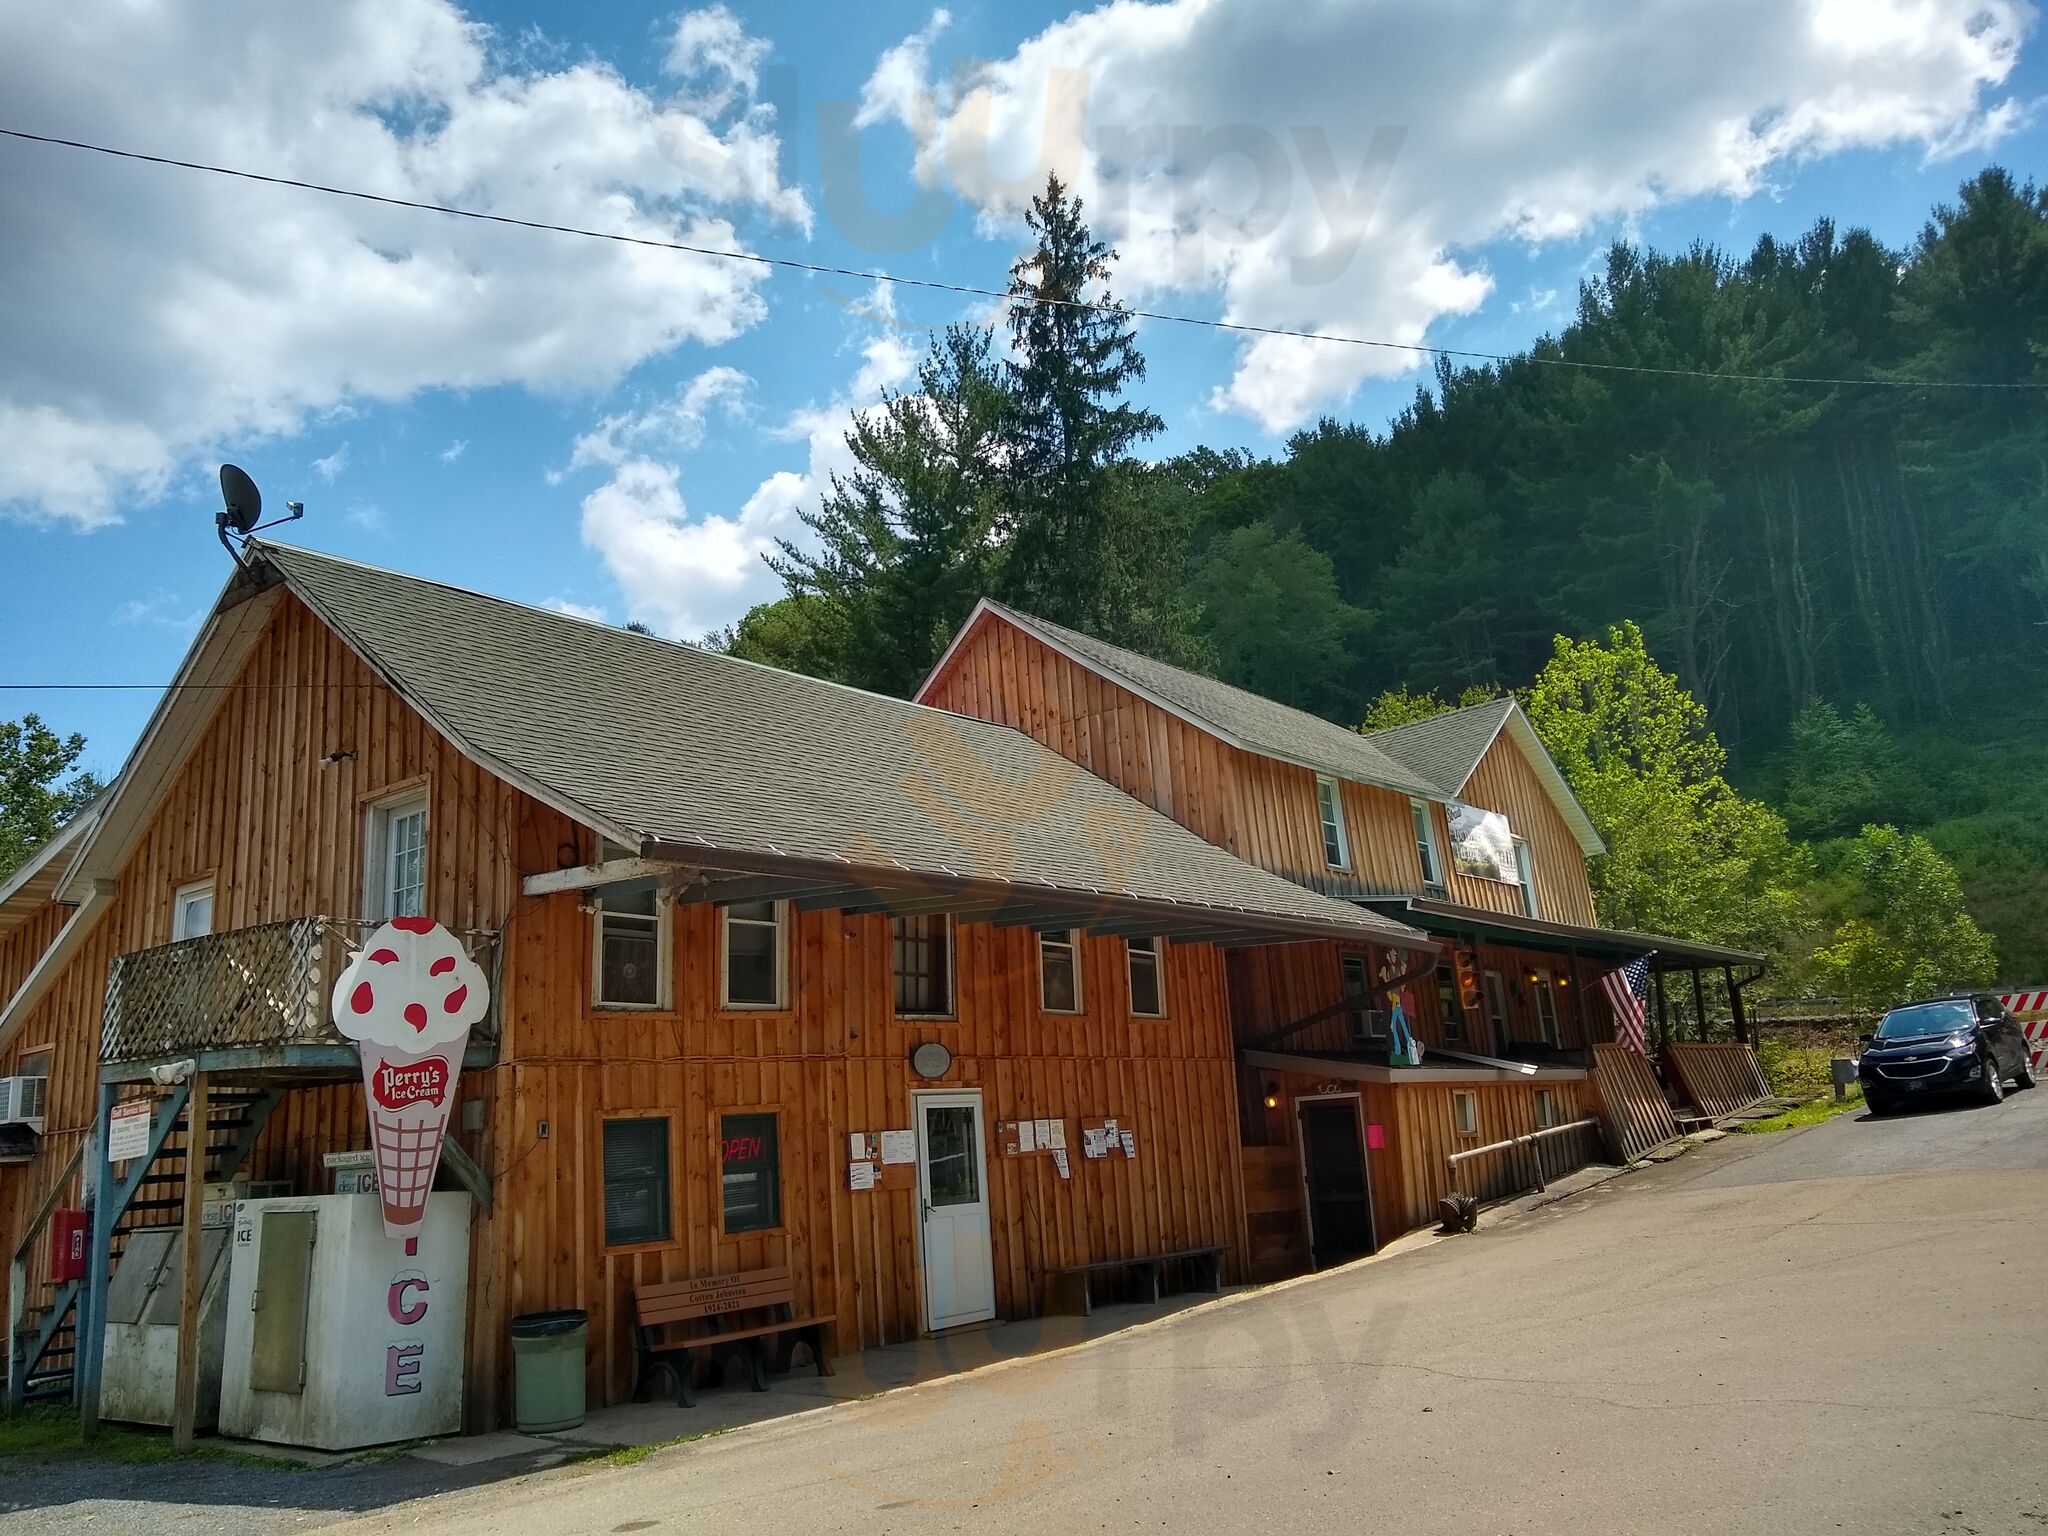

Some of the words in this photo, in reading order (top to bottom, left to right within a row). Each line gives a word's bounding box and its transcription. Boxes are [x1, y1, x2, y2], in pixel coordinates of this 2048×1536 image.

[381, 1066, 440, 1097] Perry's
[721, 1137, 761, 1162] OPEN
[338, 1180, 356, 1193] clear
[237, 1229, 253, 1242] ICE
